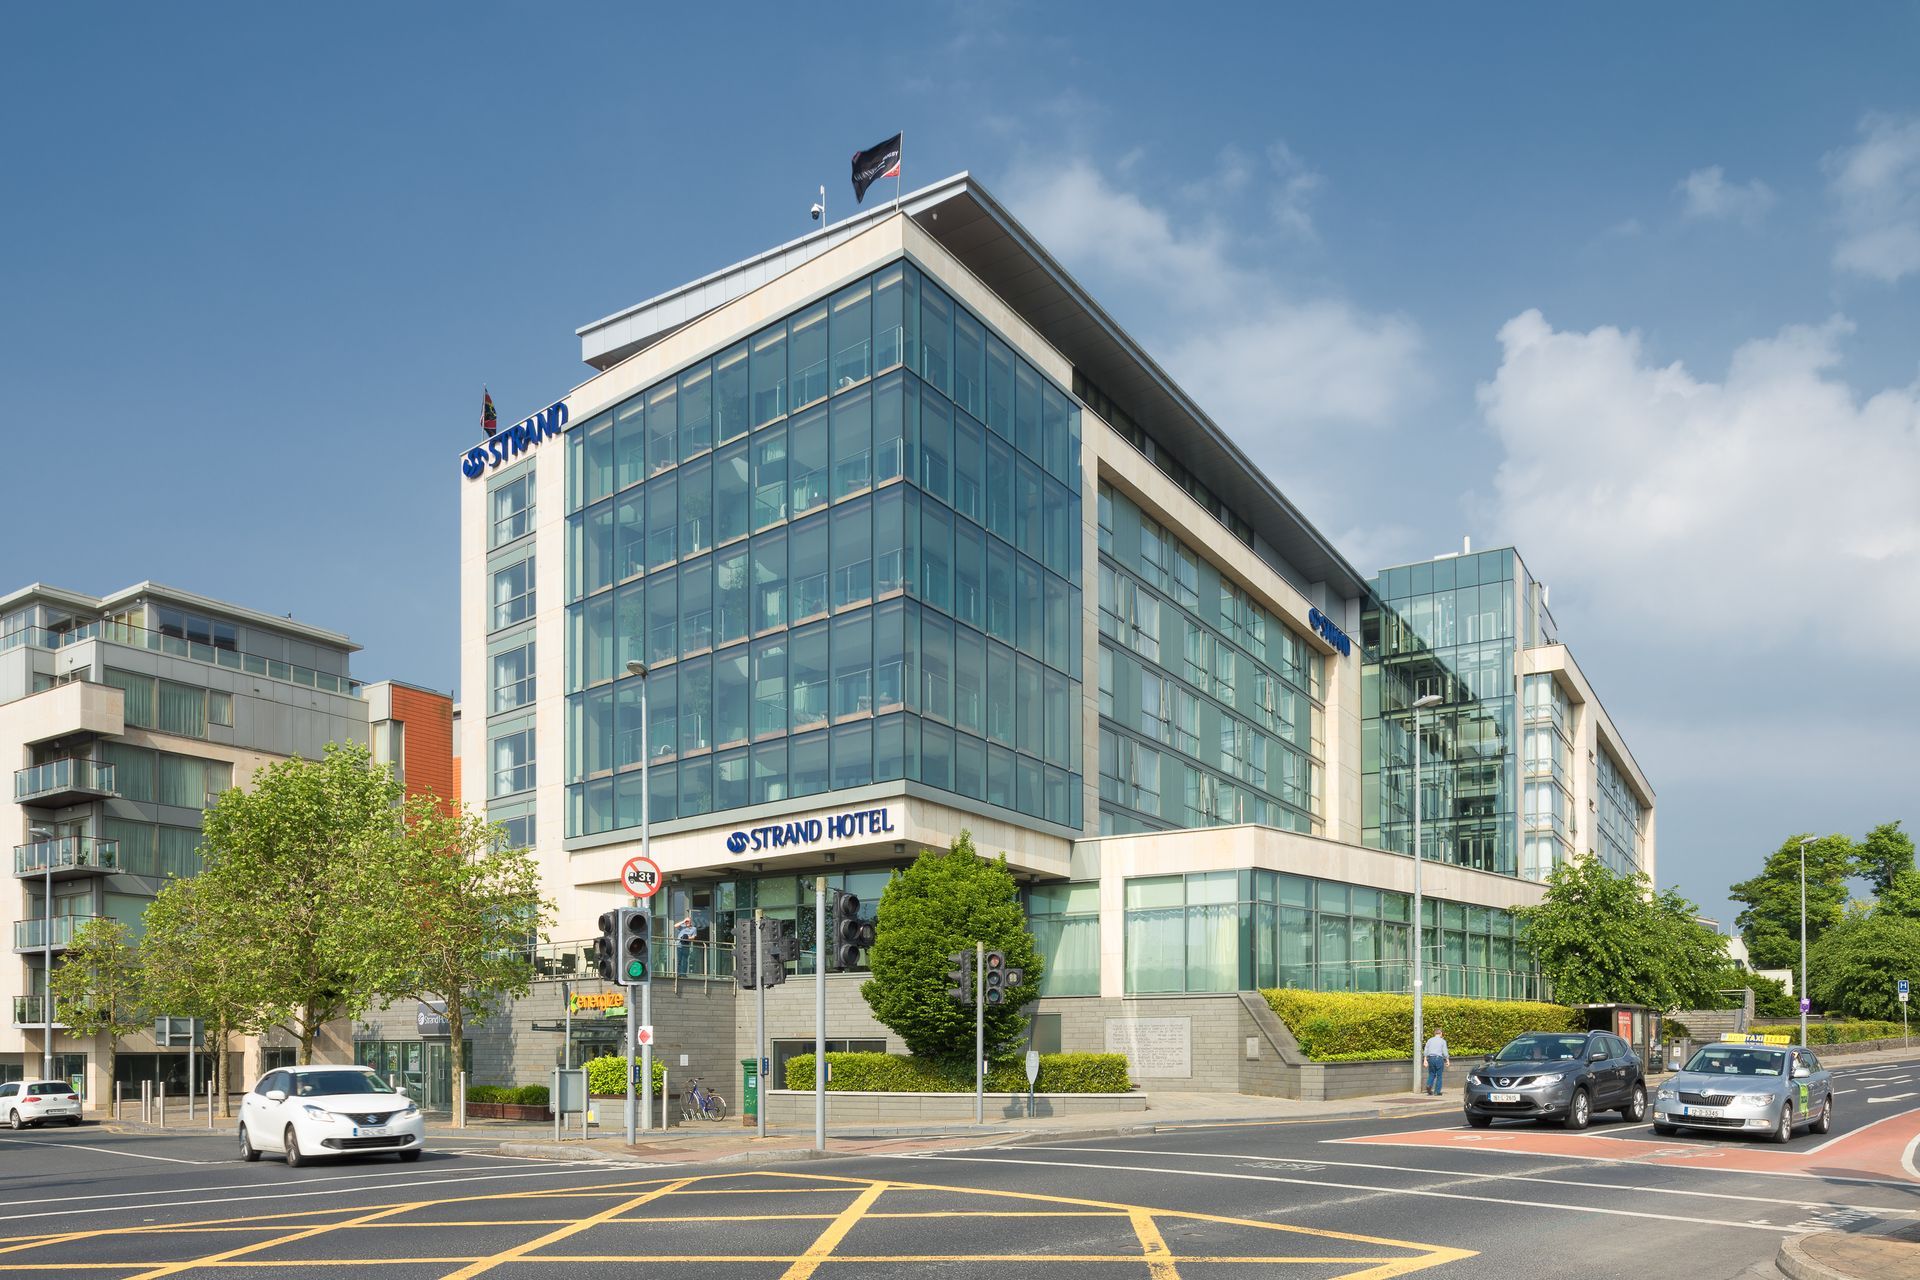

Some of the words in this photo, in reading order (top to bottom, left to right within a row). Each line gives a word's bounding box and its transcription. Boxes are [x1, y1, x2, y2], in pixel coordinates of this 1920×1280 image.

[488, 401, 569, 469] STRAND
[751, 819, 823, 851] STRAND
[828, 808, 895, 839] HOTEL
[638, 872, 651, 882] 3t
[577, 990, 624, 1011] energize
[1745, 1034, 1764, 1042] TAXI
